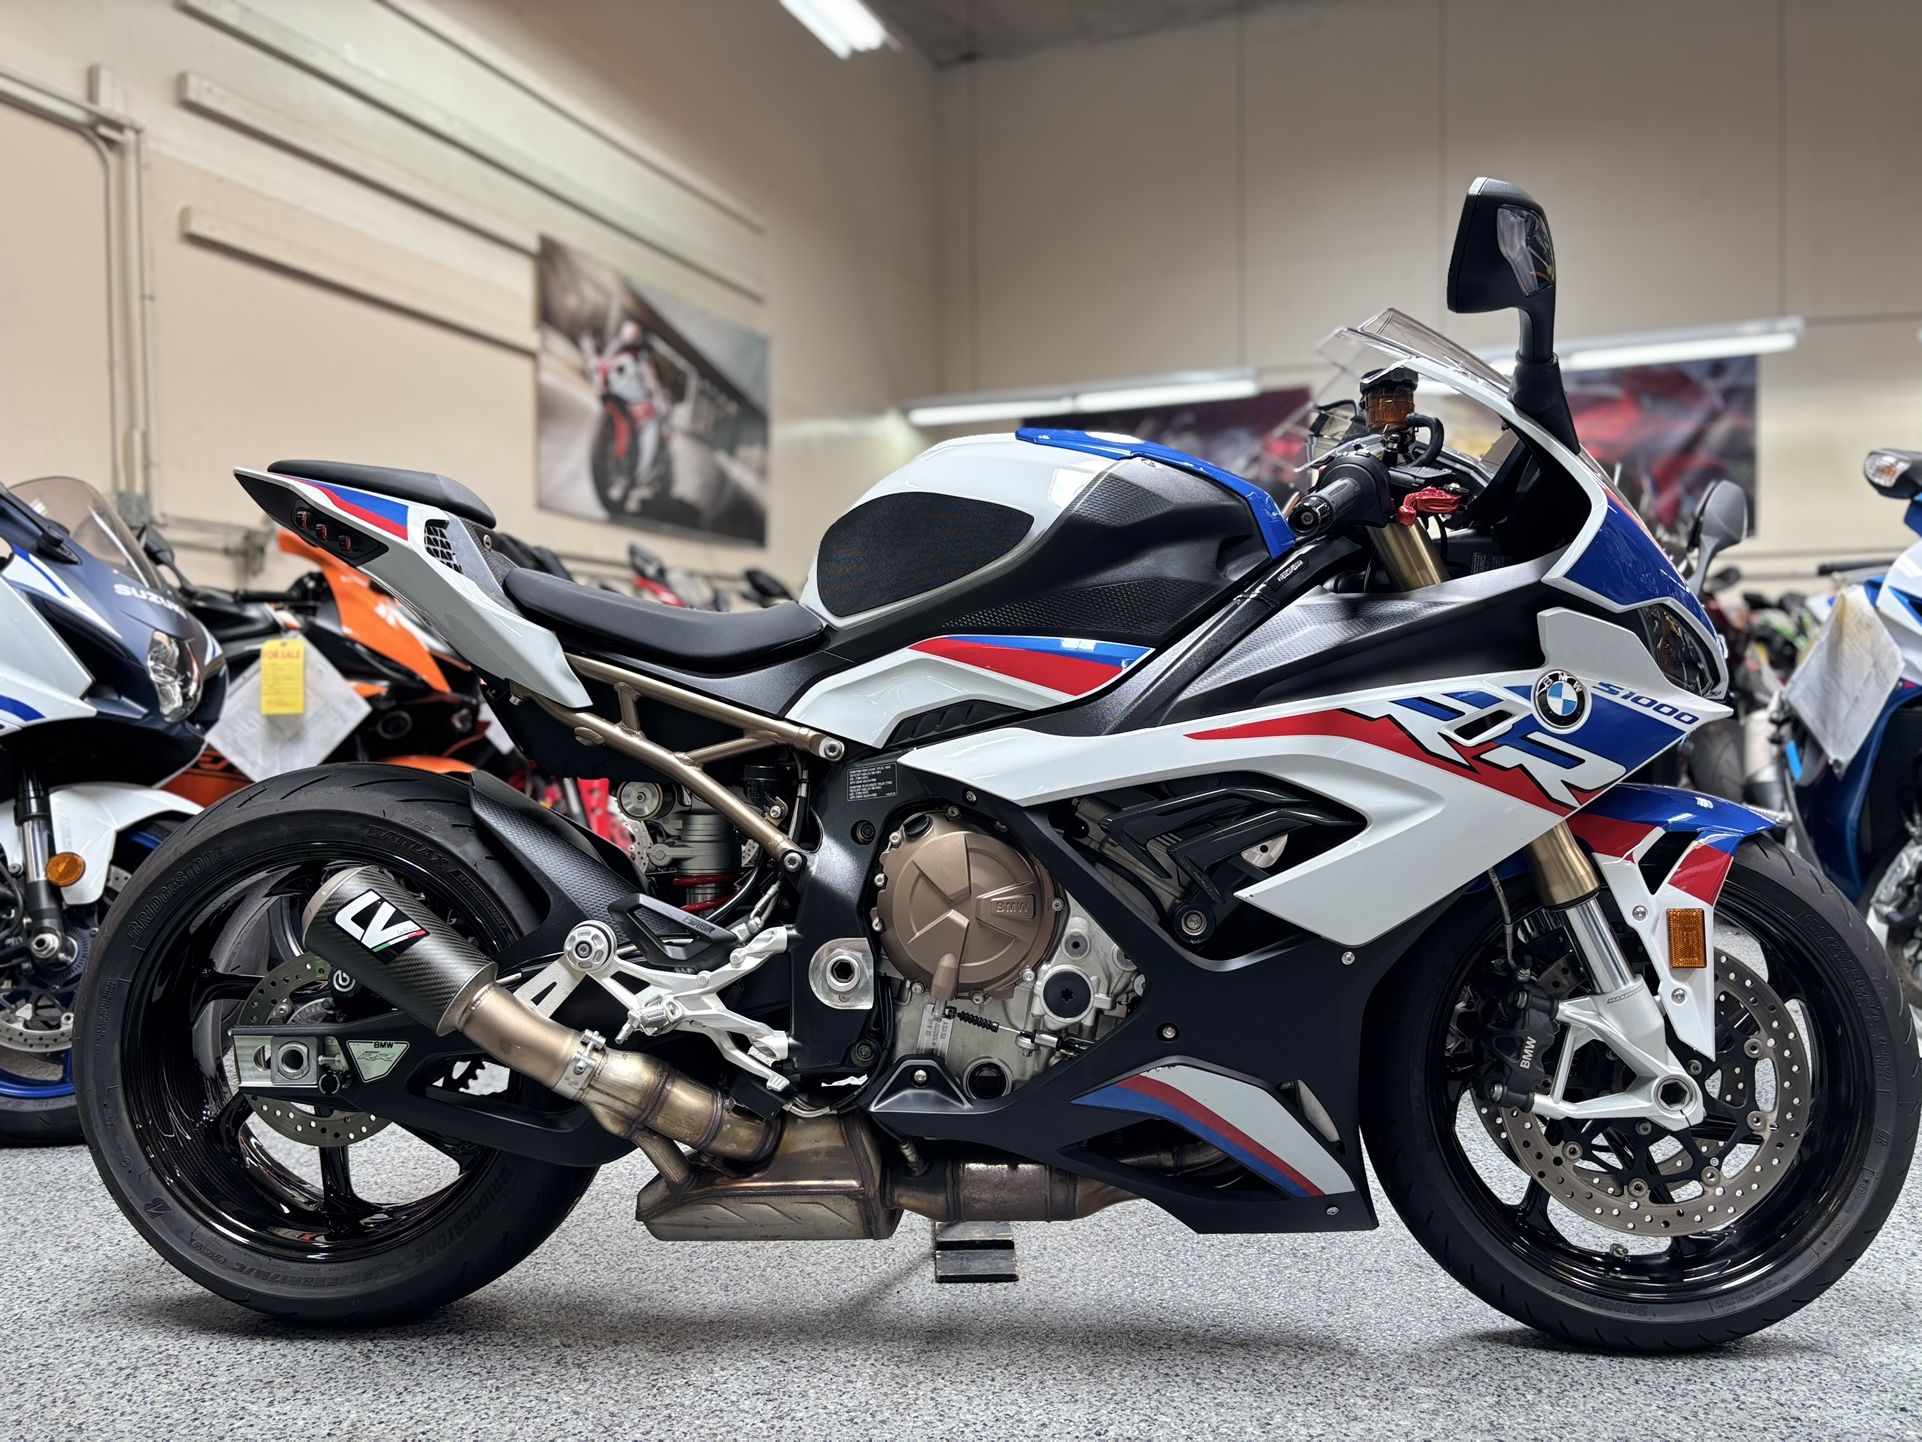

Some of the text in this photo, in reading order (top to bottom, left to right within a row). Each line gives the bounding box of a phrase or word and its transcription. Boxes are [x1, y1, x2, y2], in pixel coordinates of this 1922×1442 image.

[281, 649, 300, 659] SALE
[1592, 681, 1700, 725] S1000
[128, 846, 226, 938] BRIDGESTONE
[996, 901, 1030, 913] BMW
[1520, 1036, 1537, 1070] BMW
[416, 1162, 514, 1263] BRIDGESTONE
